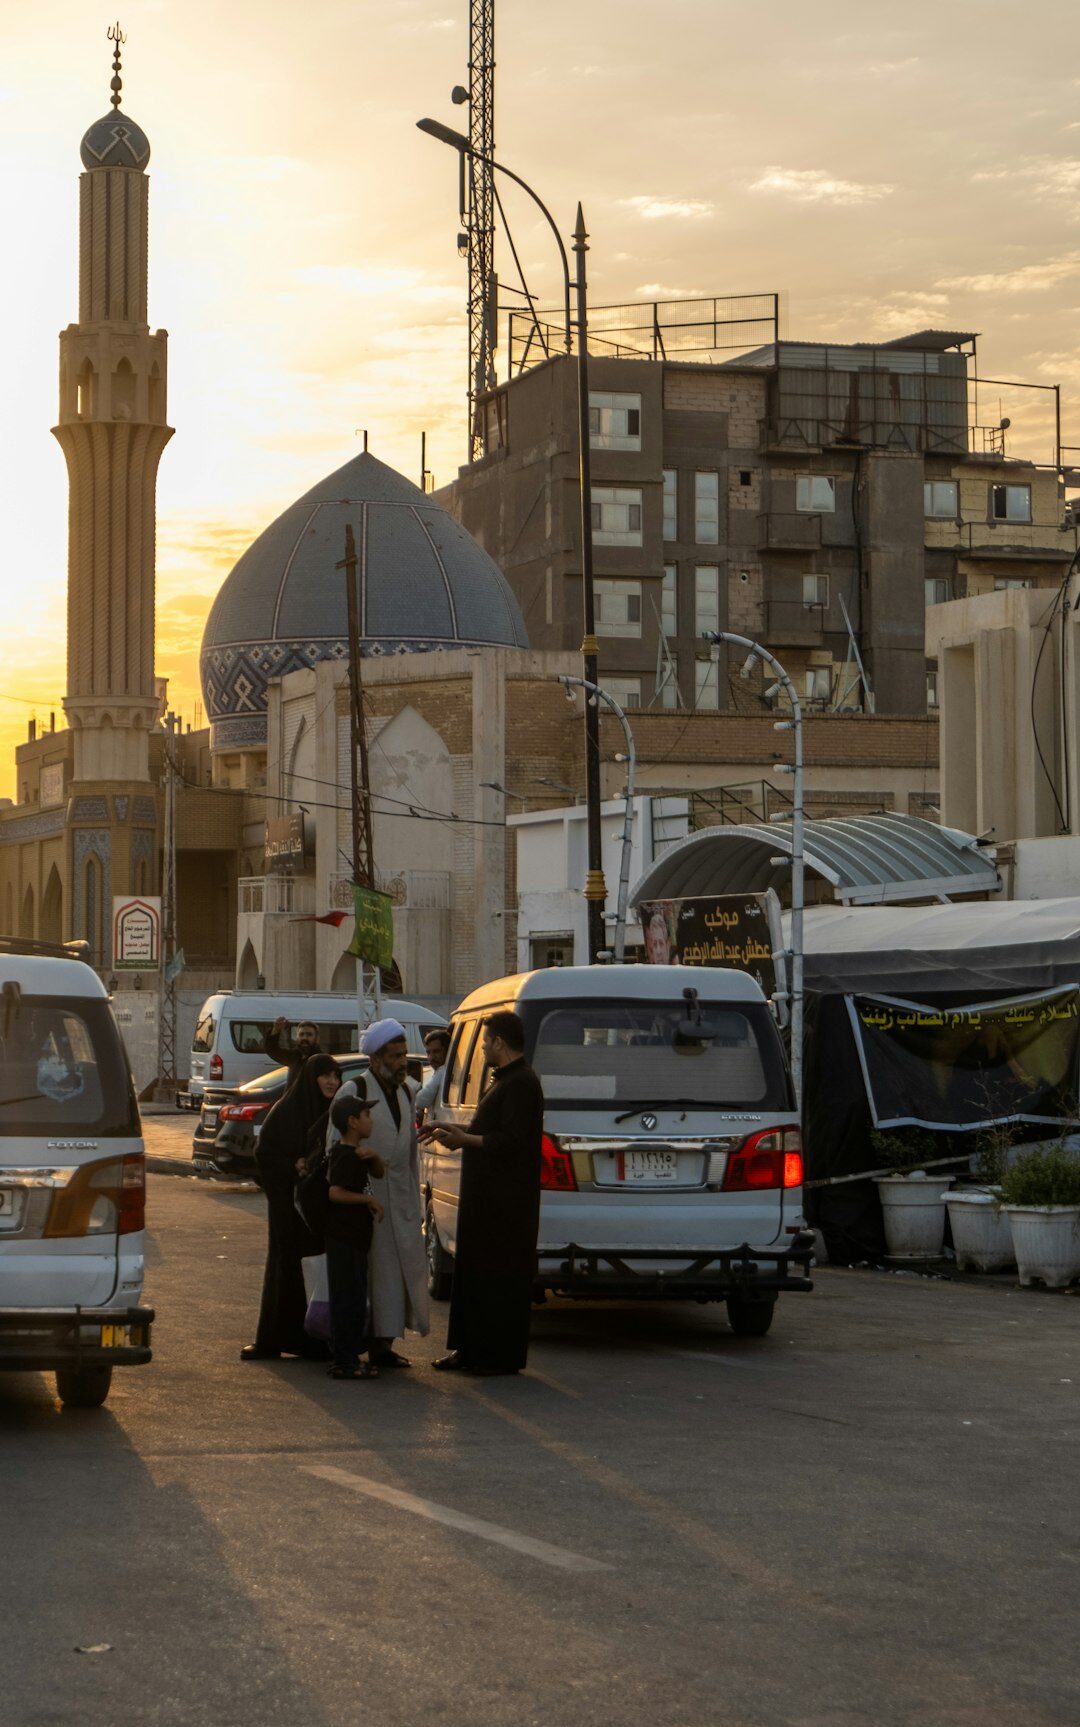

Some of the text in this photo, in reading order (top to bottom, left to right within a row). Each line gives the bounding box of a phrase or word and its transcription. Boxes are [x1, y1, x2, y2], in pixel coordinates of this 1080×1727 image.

[704, 906, 739, 931] موكب
[683, 936, 770, 965] عطش عبد الله الرضيع
[968, 1011, 982, 1030] يا
[1005, 1007, 1034, 1028] عليك
[1038, 1003, 1078, 1025] السلام
[721, 1113, 761, 1122] FOTON
[47, 1141, 98, 1150] FOTON
